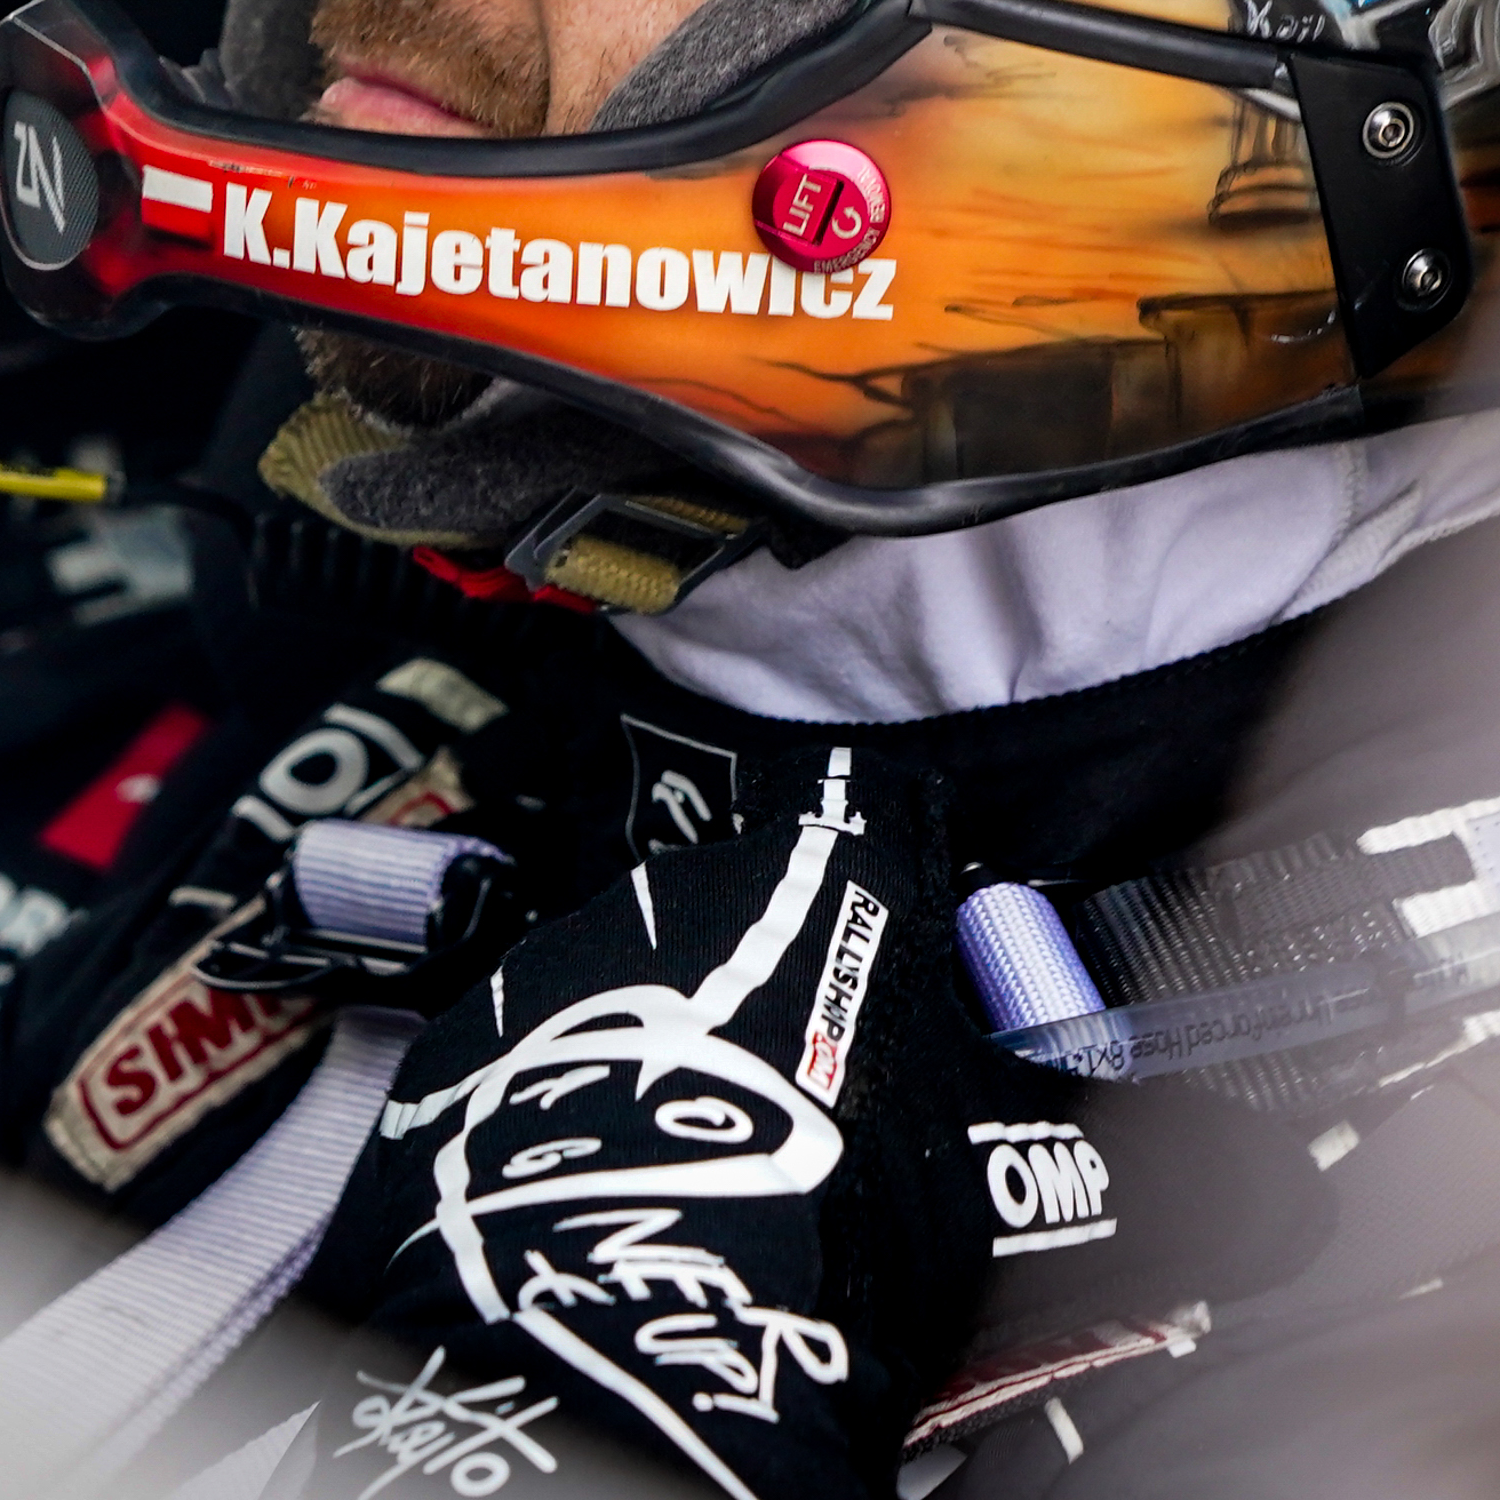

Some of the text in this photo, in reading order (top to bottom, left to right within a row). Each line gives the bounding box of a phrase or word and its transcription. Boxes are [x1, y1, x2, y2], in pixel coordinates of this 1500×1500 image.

[782, 172, 823, 237] LIFT
[222, 181, 897, 322] K.Kajetanowicz
[1130, 1026, 1185, 1062] Hose
[985, 1138, 1110, 1228] OMP
